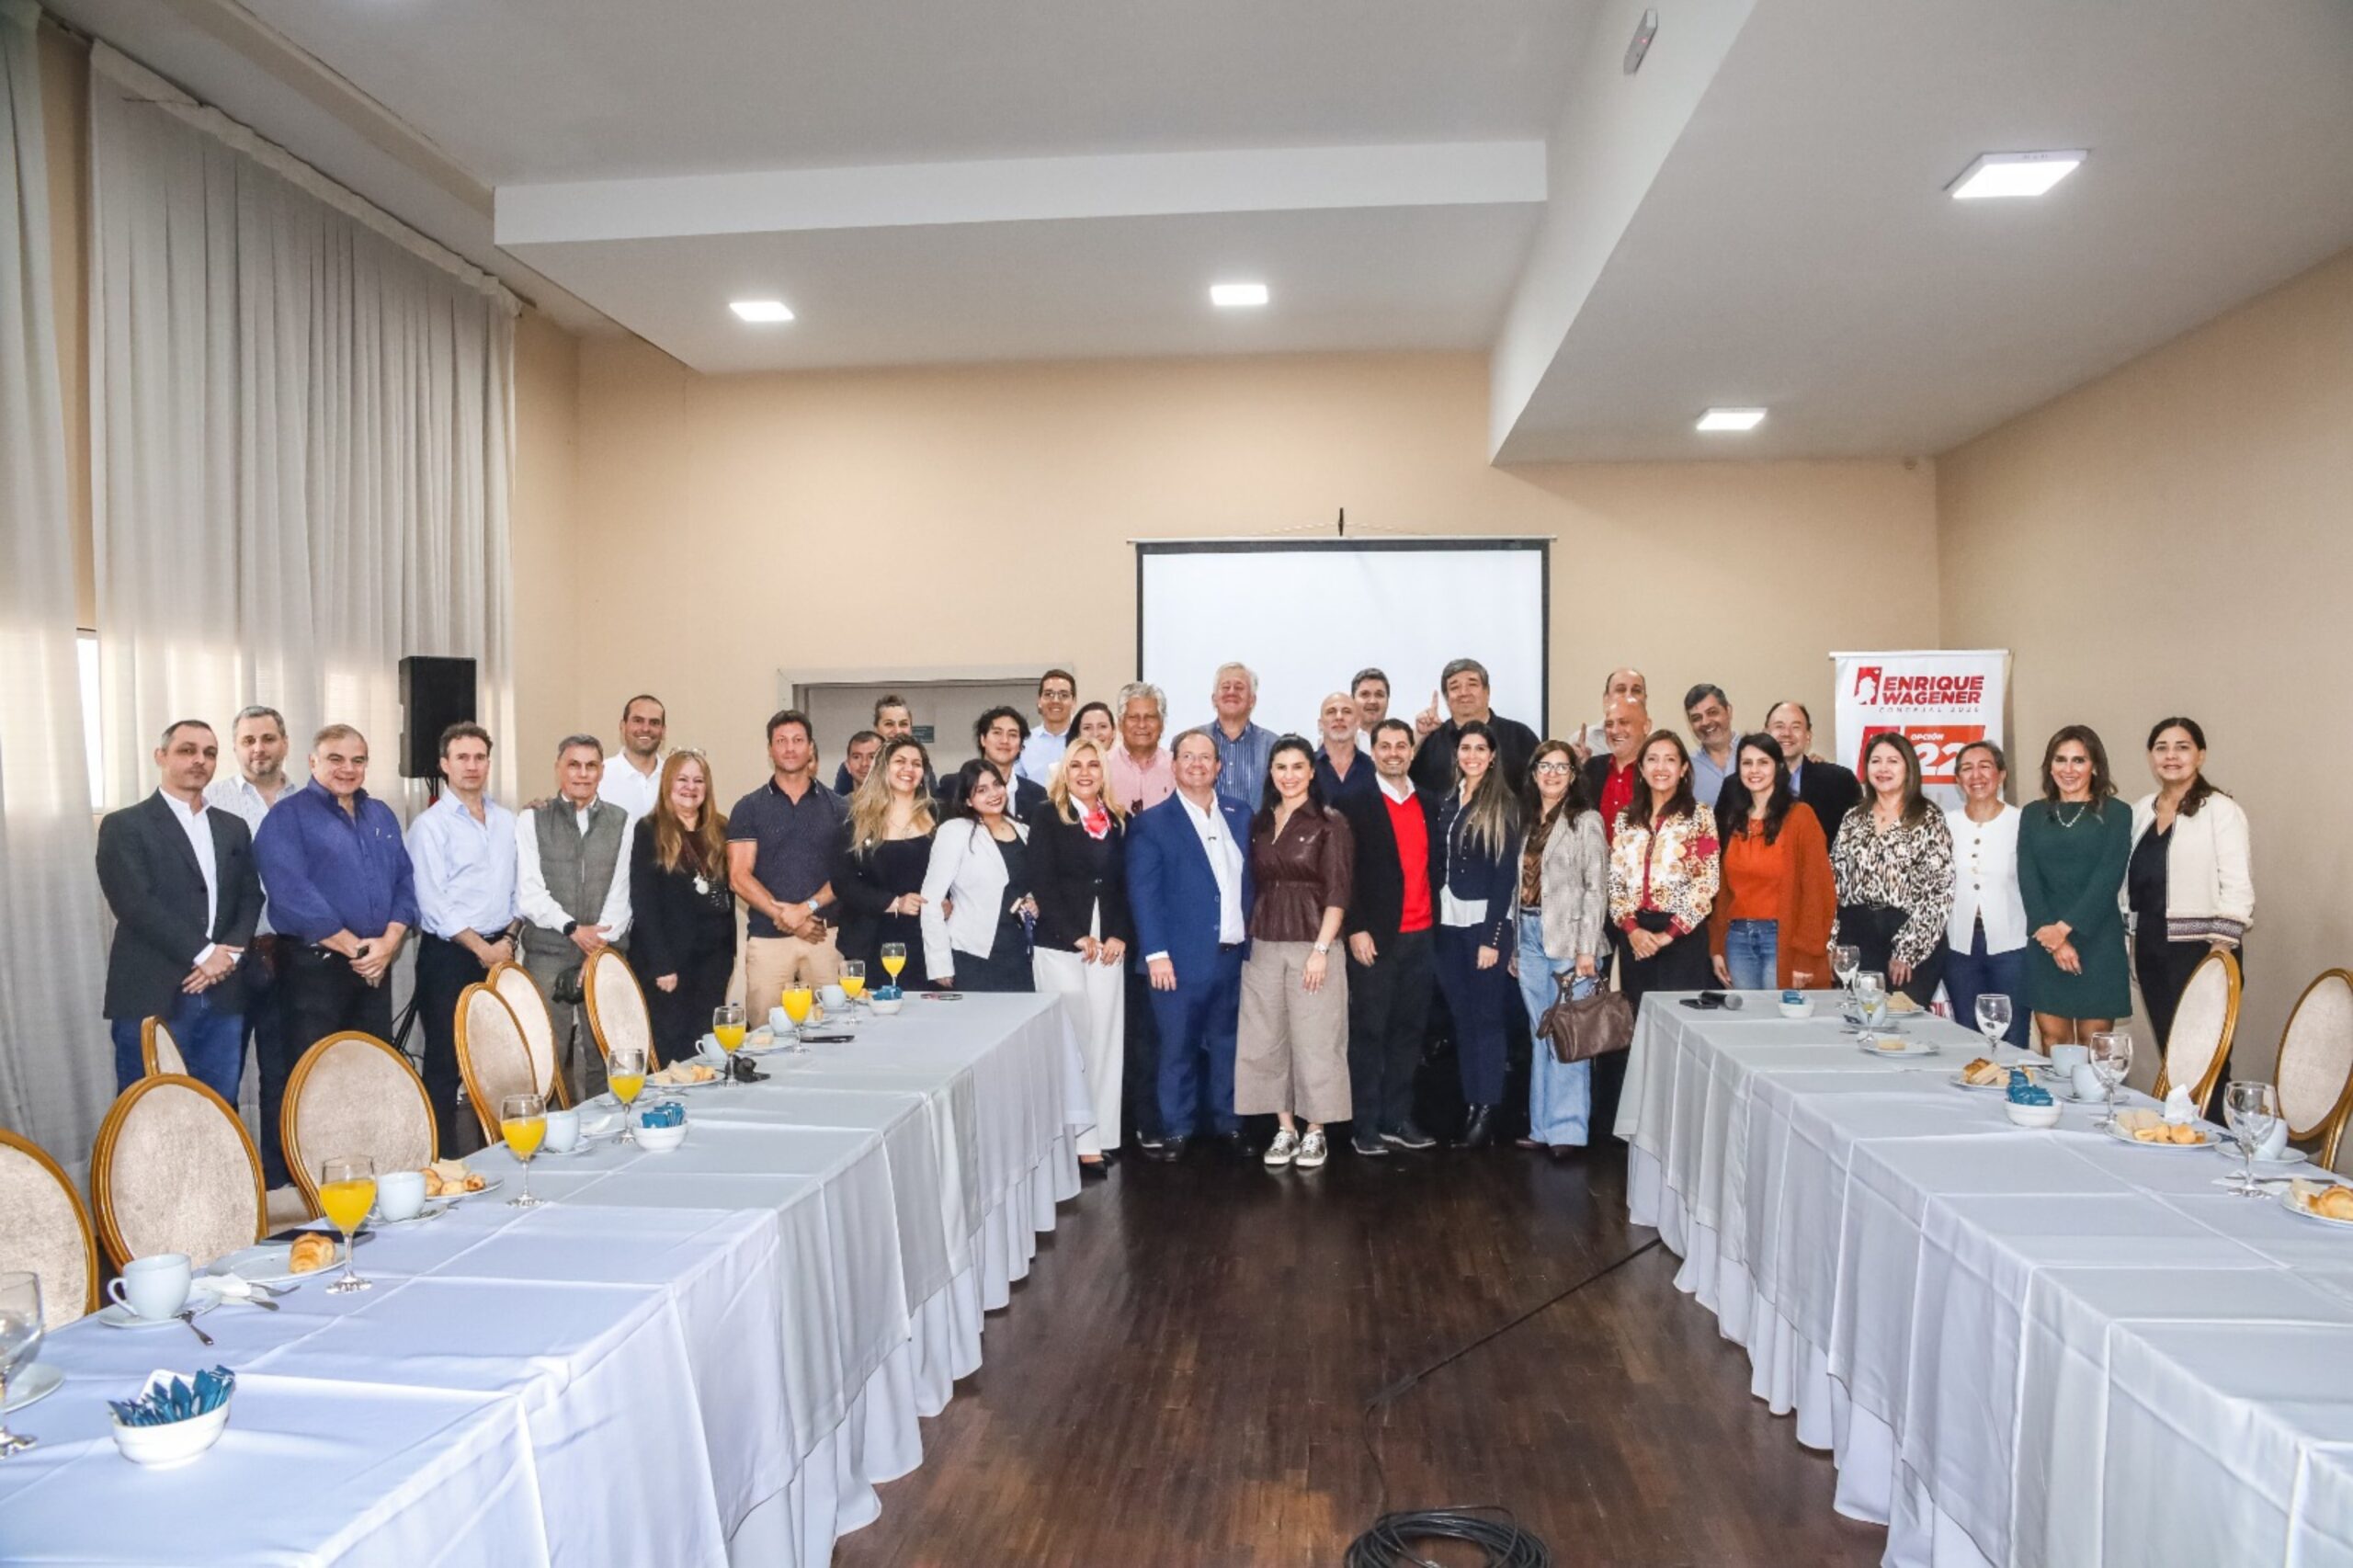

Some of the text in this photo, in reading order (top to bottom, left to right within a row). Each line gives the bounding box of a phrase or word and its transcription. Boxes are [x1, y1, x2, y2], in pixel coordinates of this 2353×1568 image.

[1883, 676, 1984, 690] ENRIQUE
[1881, 691, 1982, 705] WAGENER
[1911, 733, 1945, 741] OPCIÓN
